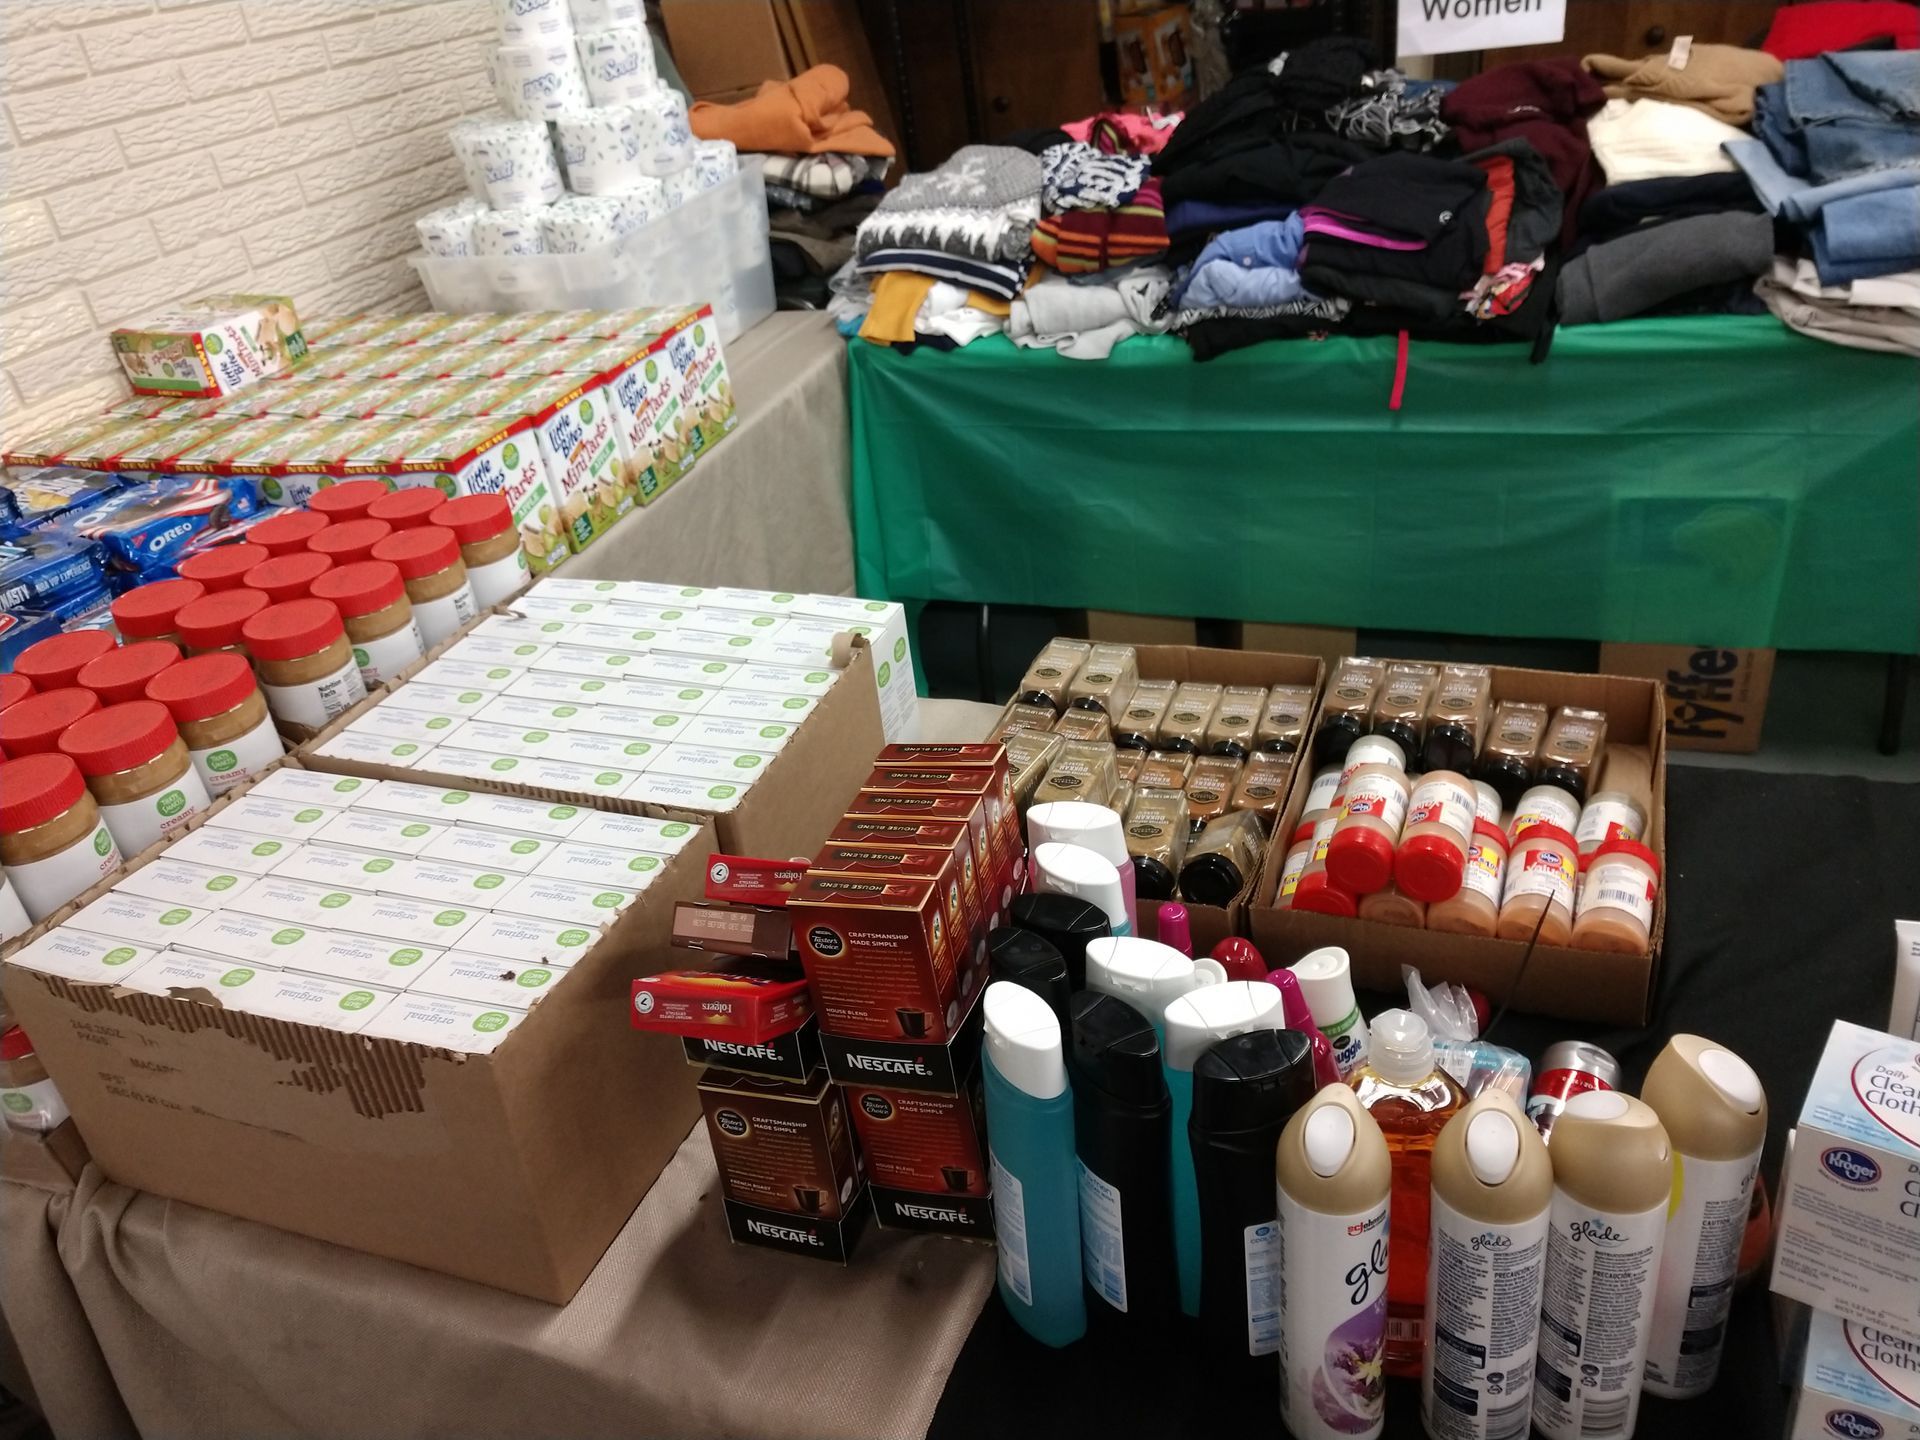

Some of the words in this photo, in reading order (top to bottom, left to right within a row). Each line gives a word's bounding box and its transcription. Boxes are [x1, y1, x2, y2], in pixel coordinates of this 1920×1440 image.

[1423, 0, 1541, 21] Women
[625, 348, 649, 368] NEW!
[195, 343, 217, 389] NEW!
[556, 387, 583, 410] NEW!
[475, 430, 508, 455] NEW!
[175, 463, 214, 472] NEW!
[232, 466, 271, 475] NEW!
[286, 464, 327, 473] NEW!
[344, 464, 387, 474] NEW!
[401, 462, 446, 472] NEW!
[149, 522, 192, 552] OREO
[318, 679, 342, 691] Nutrition
[320, 689, 337, 698] Facts
[208, 767, 247, 782] creamy
[160, 806, 195, 829] creamy
[856, 823, 886, 831] BLEND
[839, 851, 870, 859] BLEND
[871, 853, 902, 861] HOUSE
[774, 870, 802, 881] Folgers
[819, 881, 850, 889] BLEND
[851, 883, 883, 891] HOUSE
[530, 890, 576, 902] original
[493, 928, 539, 941] original
[812, 935, 838, 945] Taster's
[848, 931, 909, 941] CRAFTSMANSHIP
[814, 942, 839, 951] Choice
[850, 939, 870, 947] MADE
[326, 945, 373, 959] original
[450, 968, 500, 982] original
[275, 988, 323, 1004] original
[702, 1001, 732, 1013] Folgers
[825, 1007, 847, 1015] HOUSE
[847, 1009, 868, 1017] BLEND
[404, 1011, 454, 1026] original
[1335, 1038, 1362, 1063] uggle
[1875, 1064, 1910, 1081] Daily
[897, 1099, 954, 1109] CRAFTSMANSHIP
[752, 1116, 807, 1128] CRAFTSMANSHIP
[753, 1123, 772, 1131] MADE
[773, 1126, 797, 1134] SIMPLE
[1828, 1151, 1876, 1180] Kroger
[1570, 1220, 1630, 1248] glade
[1470, 1233, 1512, 1251] glade
